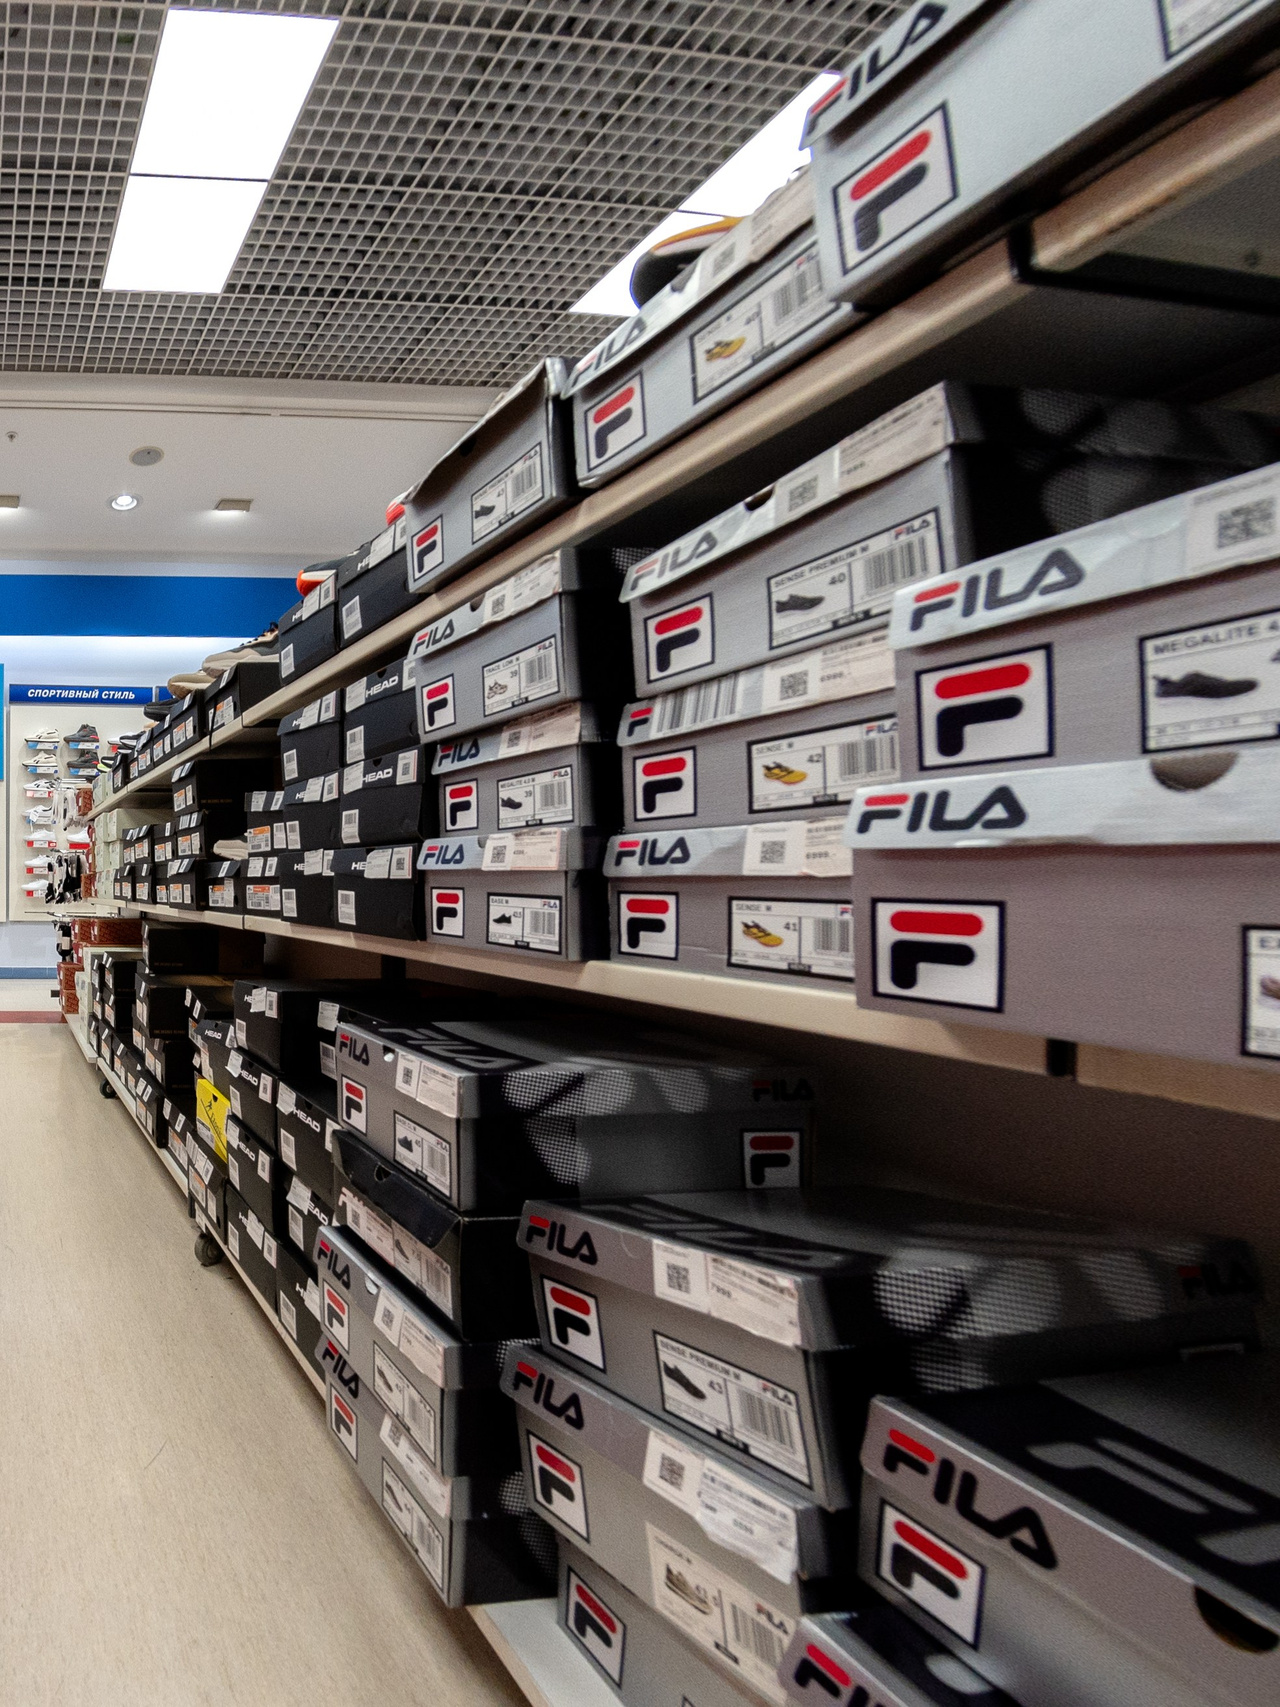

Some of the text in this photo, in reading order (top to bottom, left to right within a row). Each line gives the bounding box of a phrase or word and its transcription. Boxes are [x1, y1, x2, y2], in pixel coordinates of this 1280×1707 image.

[806, 5, 946, 135] FILA
[571, 315, 647, 388] FILA
[894, 519, 931, 540] FILA
[630, 529, 719, 592] FILA
[774, 569, 807, 588] SENSE
[808, 550, 858, 574] PREMIUM
[828, 572, 847, 586] 40
[910, 547, 1087, 632] FILA
[413, 618, 455, 655] FILA
[1152, 624, 1257, 656] MEGALITE
[27, 688, 136, 700] СПОРТИВНЫЙ СТИЛЬ
[365, 675, 399, 698] HEAD
[437, 738, 481, 768] FILA
[755, 744, 784, 755] SENSE
[806, 753, 823, 764] 42
[362, 767, 393, 783] HEAD
[524, 789, 533, 798] 39
[856, 785, 1027, 834] FILA
[422, 843, 465, 866] FILA
[614, 836, 691, 867] FILA
[734, 903, 762, 912] SENSE
[783, 921, 798, 932] 41
[204, 1029, 222, 1040] HEAD
[338, 1033, 369, 1066] FILA
[238, 1069, 258, 1087] HEAD
[293, 1106, 321, 1133] HEAD
[236, 1139, 256, 1162] HEAD
[307, 1200, 329, 1226] EAD
[526, 1215, 598, 1266] FILA
[317, 1239, 351, 1291] FILA
[322, 1338, 360, 1400] FILA
[512, 1360, 585, 1431] FILA
[761, 1381, 793, 1406] FILA
[883, 1428, 1059, 1570] FILA
